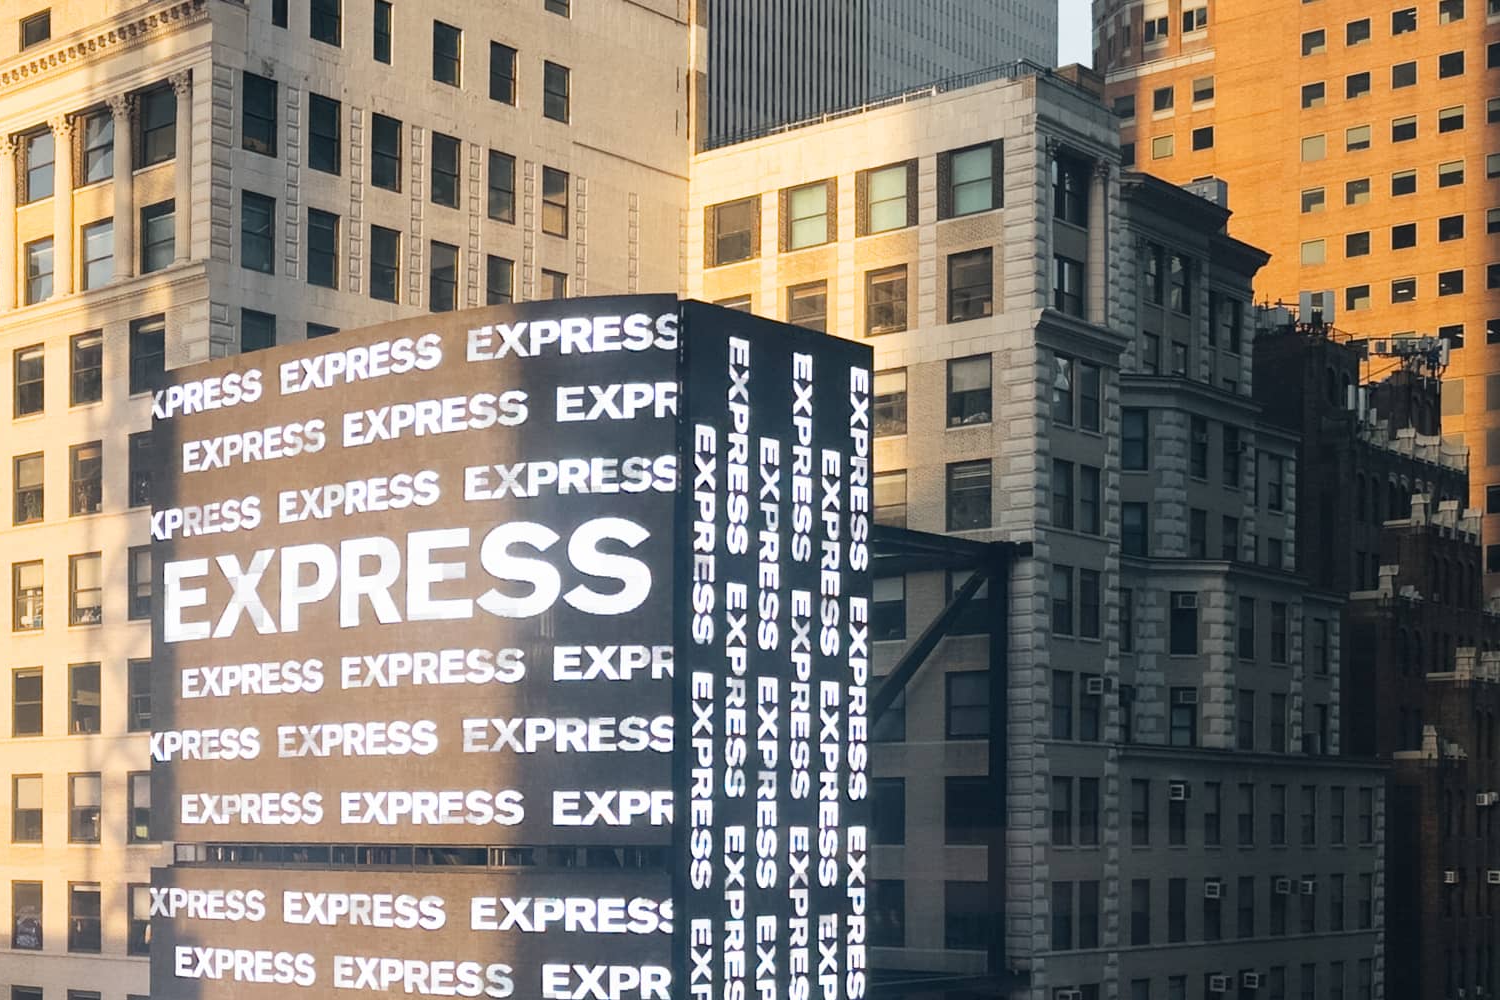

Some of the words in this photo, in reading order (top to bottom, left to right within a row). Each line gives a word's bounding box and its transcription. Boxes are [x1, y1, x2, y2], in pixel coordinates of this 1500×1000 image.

[182, 418, 325, 473] EXPRESS
[343, 390, 528, 447] EXPRESS
[557, 381, 676, 422] EXPR
[280, 333, 442, 395] EXPRESS
[467, 313, 677, 362] EXPRESS
[726, 336, 750, 556] EXPRESS
[279, 470, 440, 523] EXPRESS
[464, 455, 676, 501] EXPRESS
[692, 424, 717, 646] EXPRESS
[757, 437, 780, 652] EXPRESS
[791, 352, 813, 563] EXPRESS
[820, 448, 841, 657] EXPRESS
[849, 366, 869, 572] EXPRESS
[164, 517, 651, 643] EXPRESS
[182, 658, 323, 699] EXPRESS
[341, 647, 525, 689] EXPRESS
[553, 645, 674, 681] EXPR
[278, 720, 438, 759] EXPRESS
[463, 716, 674, 754] EXPRESS
[690, 671, 714, 889] EXPRESS
[725, 582, 747, 798] EXPRESS
[756, 676, 779, 889] EXPRESS
[790, 589, 811, 799] EXPRESS
[819, 680, 840, 887] EXPRESS
[847, 596, 868, 801] EXPRESS
[181, 792, 322, 825] EXPRESS
[340, 790, 524, 826] EXPRESS
[553, 791, 673, 826] EXPR
[283, 891, 446, 930] EXPRESS
[175, 945, 315, 986] EXPRESS
[333, 955, 514, 999] EXPRESS
[542, 964, 671, 1000] EXPR
